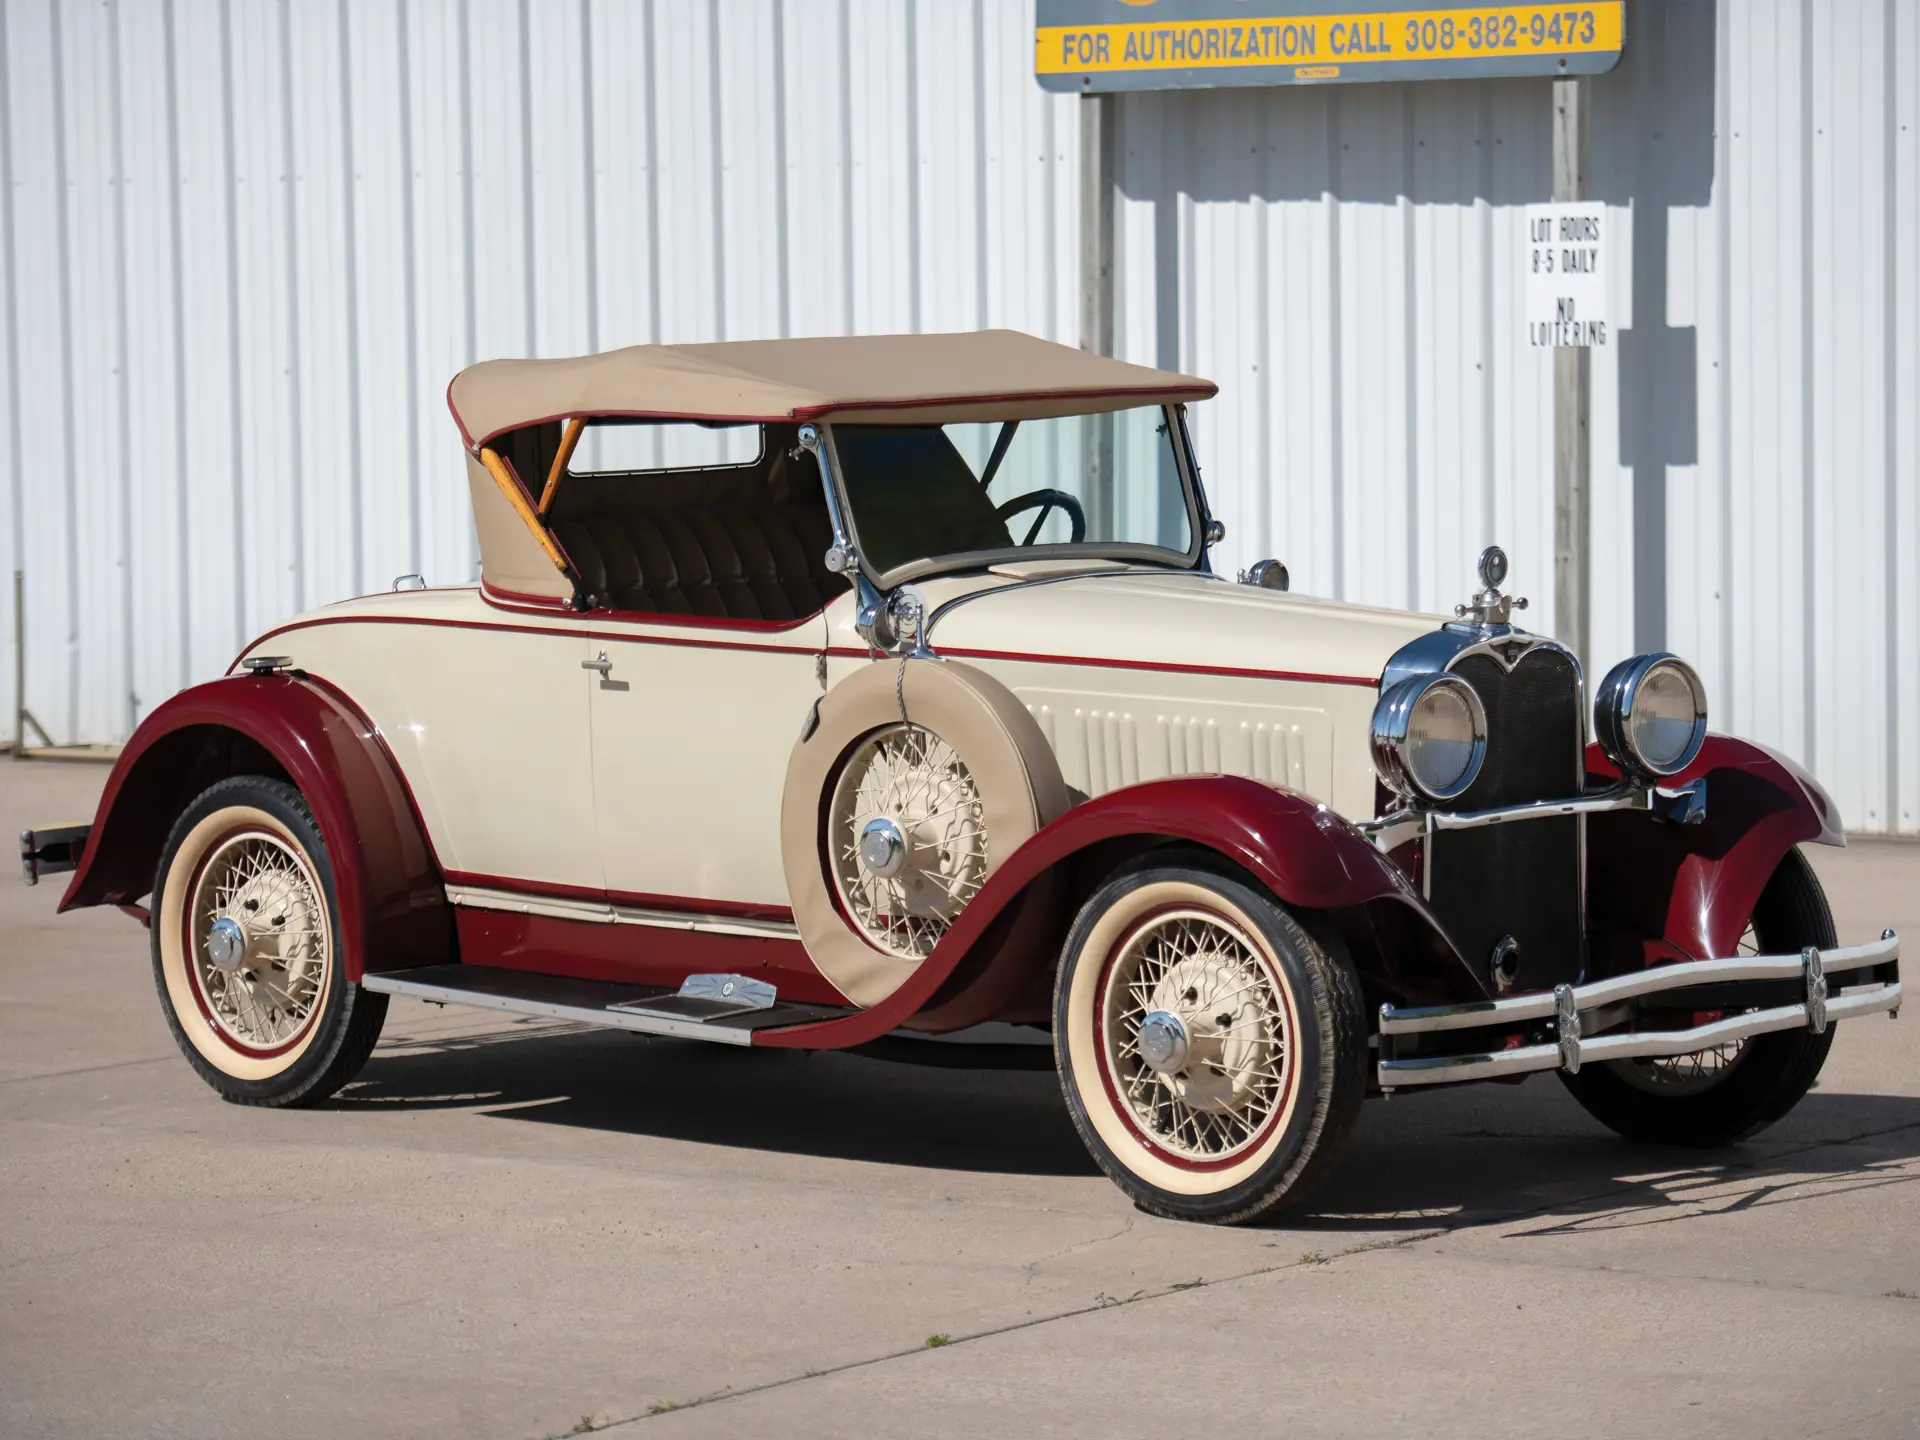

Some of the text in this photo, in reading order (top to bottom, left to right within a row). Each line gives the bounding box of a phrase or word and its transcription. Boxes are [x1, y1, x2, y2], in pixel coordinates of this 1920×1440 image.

[1062, 10, 1596, 65] FOR AUTHORIZATION CALL 308-382-9473
[1531, 217, 1600, 243] LOT HOURS
[1532, 249, 1598, 274] 8-5 DAILY
[1556, 297, 1575, 322] NO
[1530, 320, 1606, 346] LOITERING
